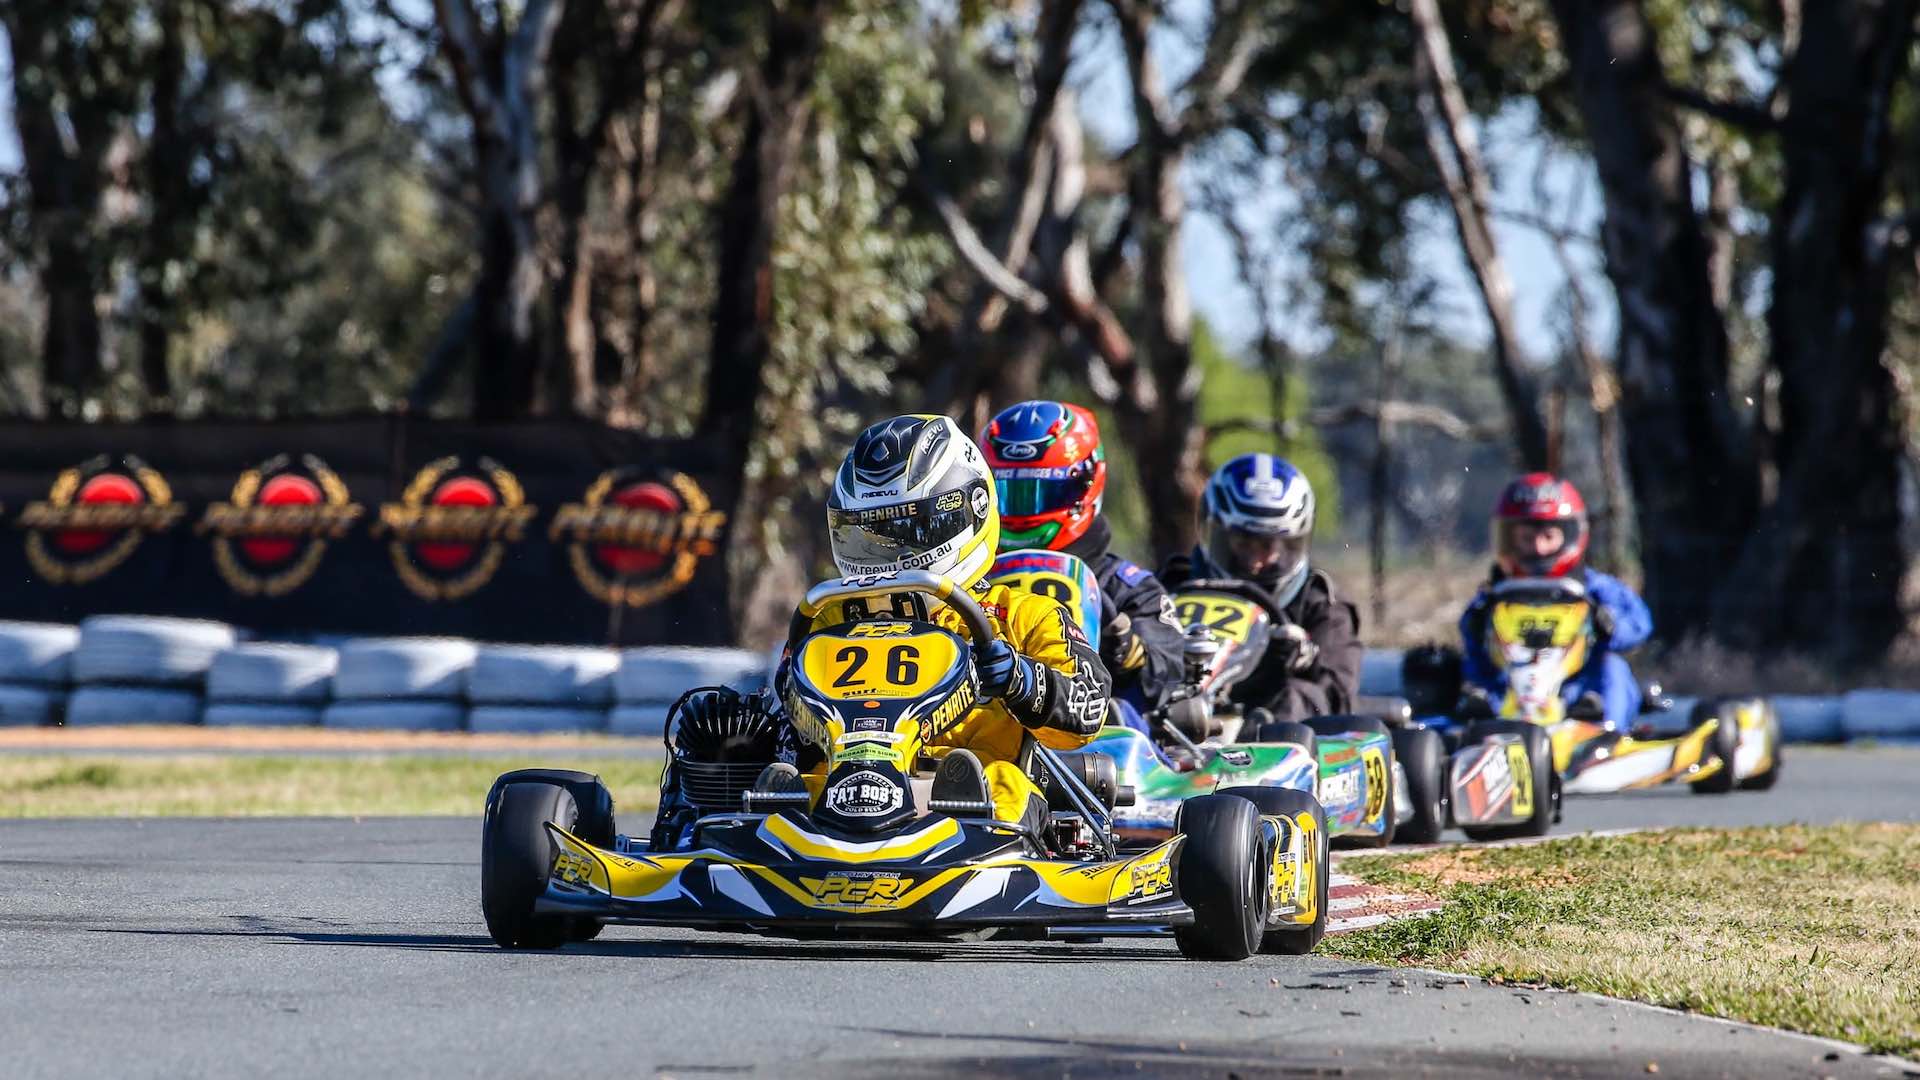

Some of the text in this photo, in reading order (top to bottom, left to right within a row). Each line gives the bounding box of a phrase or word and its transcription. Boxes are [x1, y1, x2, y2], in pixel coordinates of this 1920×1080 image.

[920, 423, 943, 454] REEVU
[860, 502, 918, 523] PENRITE
[847, 624, 913, 639] PCR
[1176, 602, 1244, 636] 92
[832, 645, 920, 689] 26
[931, 679, 975, 736] PENRITE
[826, 784, 904, 808] FAT BOB'S
[554, 854, 593, 884] PCR
[1128, 863, 1173, 897] PCR
[816, 878, 900, 903] PCR
